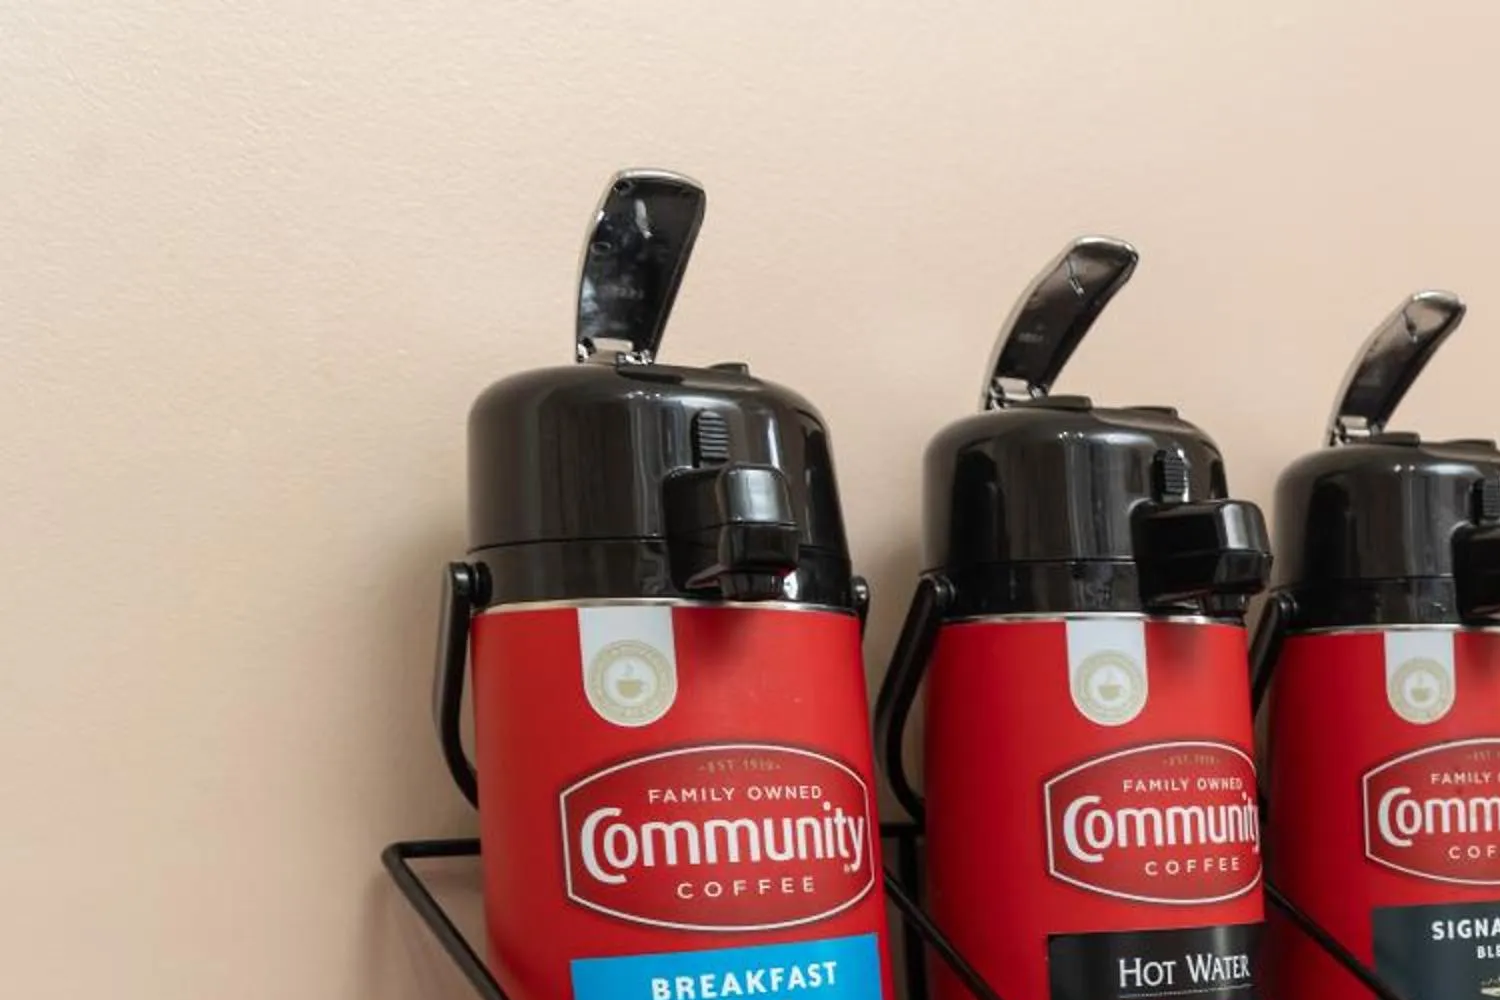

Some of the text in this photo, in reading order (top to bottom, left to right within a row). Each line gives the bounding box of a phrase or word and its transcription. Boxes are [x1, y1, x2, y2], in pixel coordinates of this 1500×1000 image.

[1123, 777, 1243, 793] FAMILY OWNED
[1430, 772, 1491, 785] FAMILY
[648, 785, 821, 804] FAMILY OWNED
[1064, 791, 1260, 863] Community
[581, 802, 864, 884] Community
[1145, 857, 1240, 876] COFFEE
[677, 877, 815, 899] COFFEE
